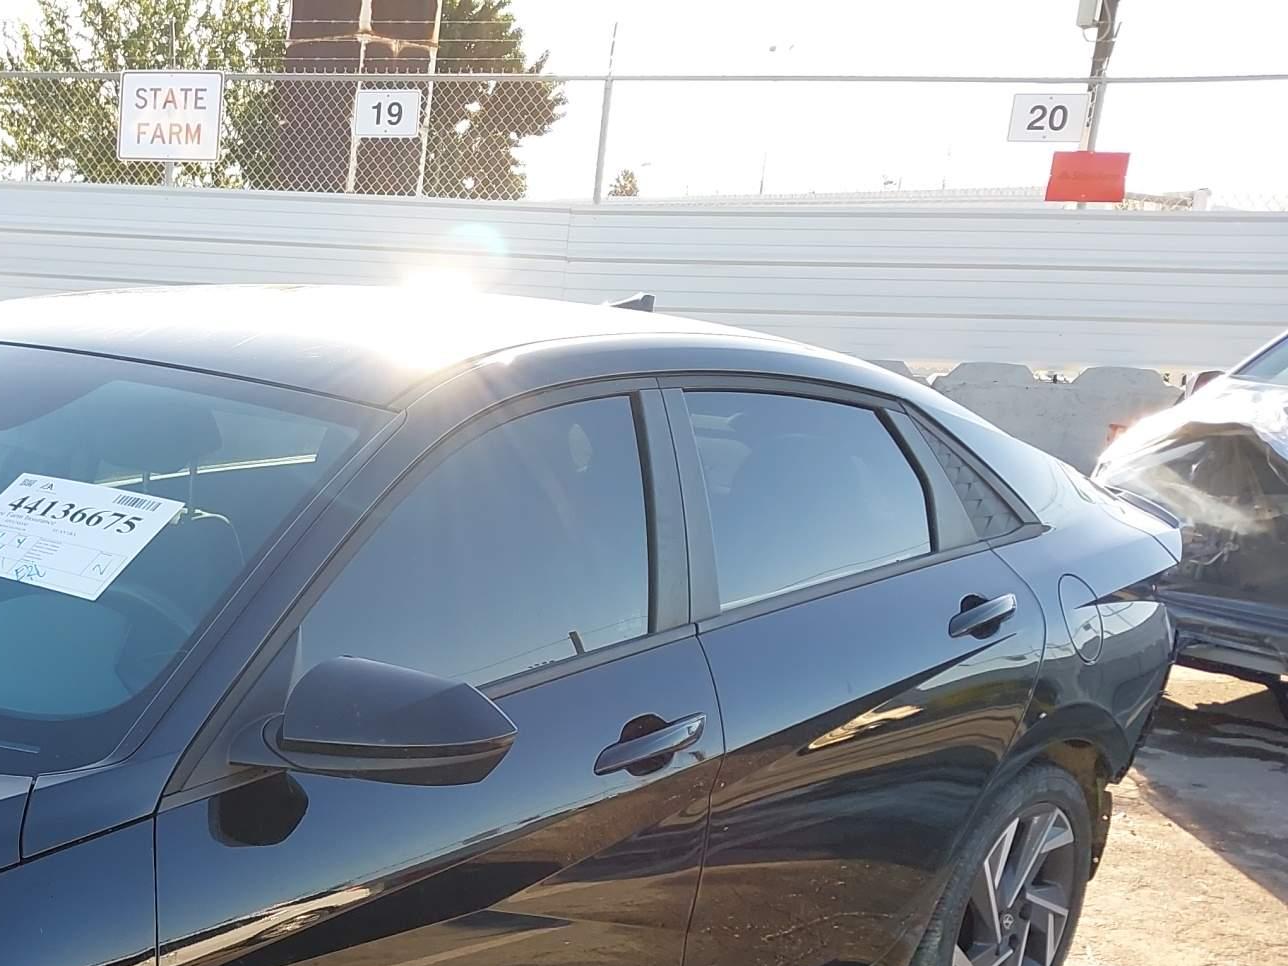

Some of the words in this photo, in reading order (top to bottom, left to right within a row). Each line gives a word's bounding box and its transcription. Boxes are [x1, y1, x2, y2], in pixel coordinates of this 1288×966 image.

[135, 87, 208, 110] STATE
[371, 101, 403, 126] 19
[1026, 104, 1069, 131] 20
[136, 122, 202, 145] FARM
[8, 494, 144, 534] 44136675
